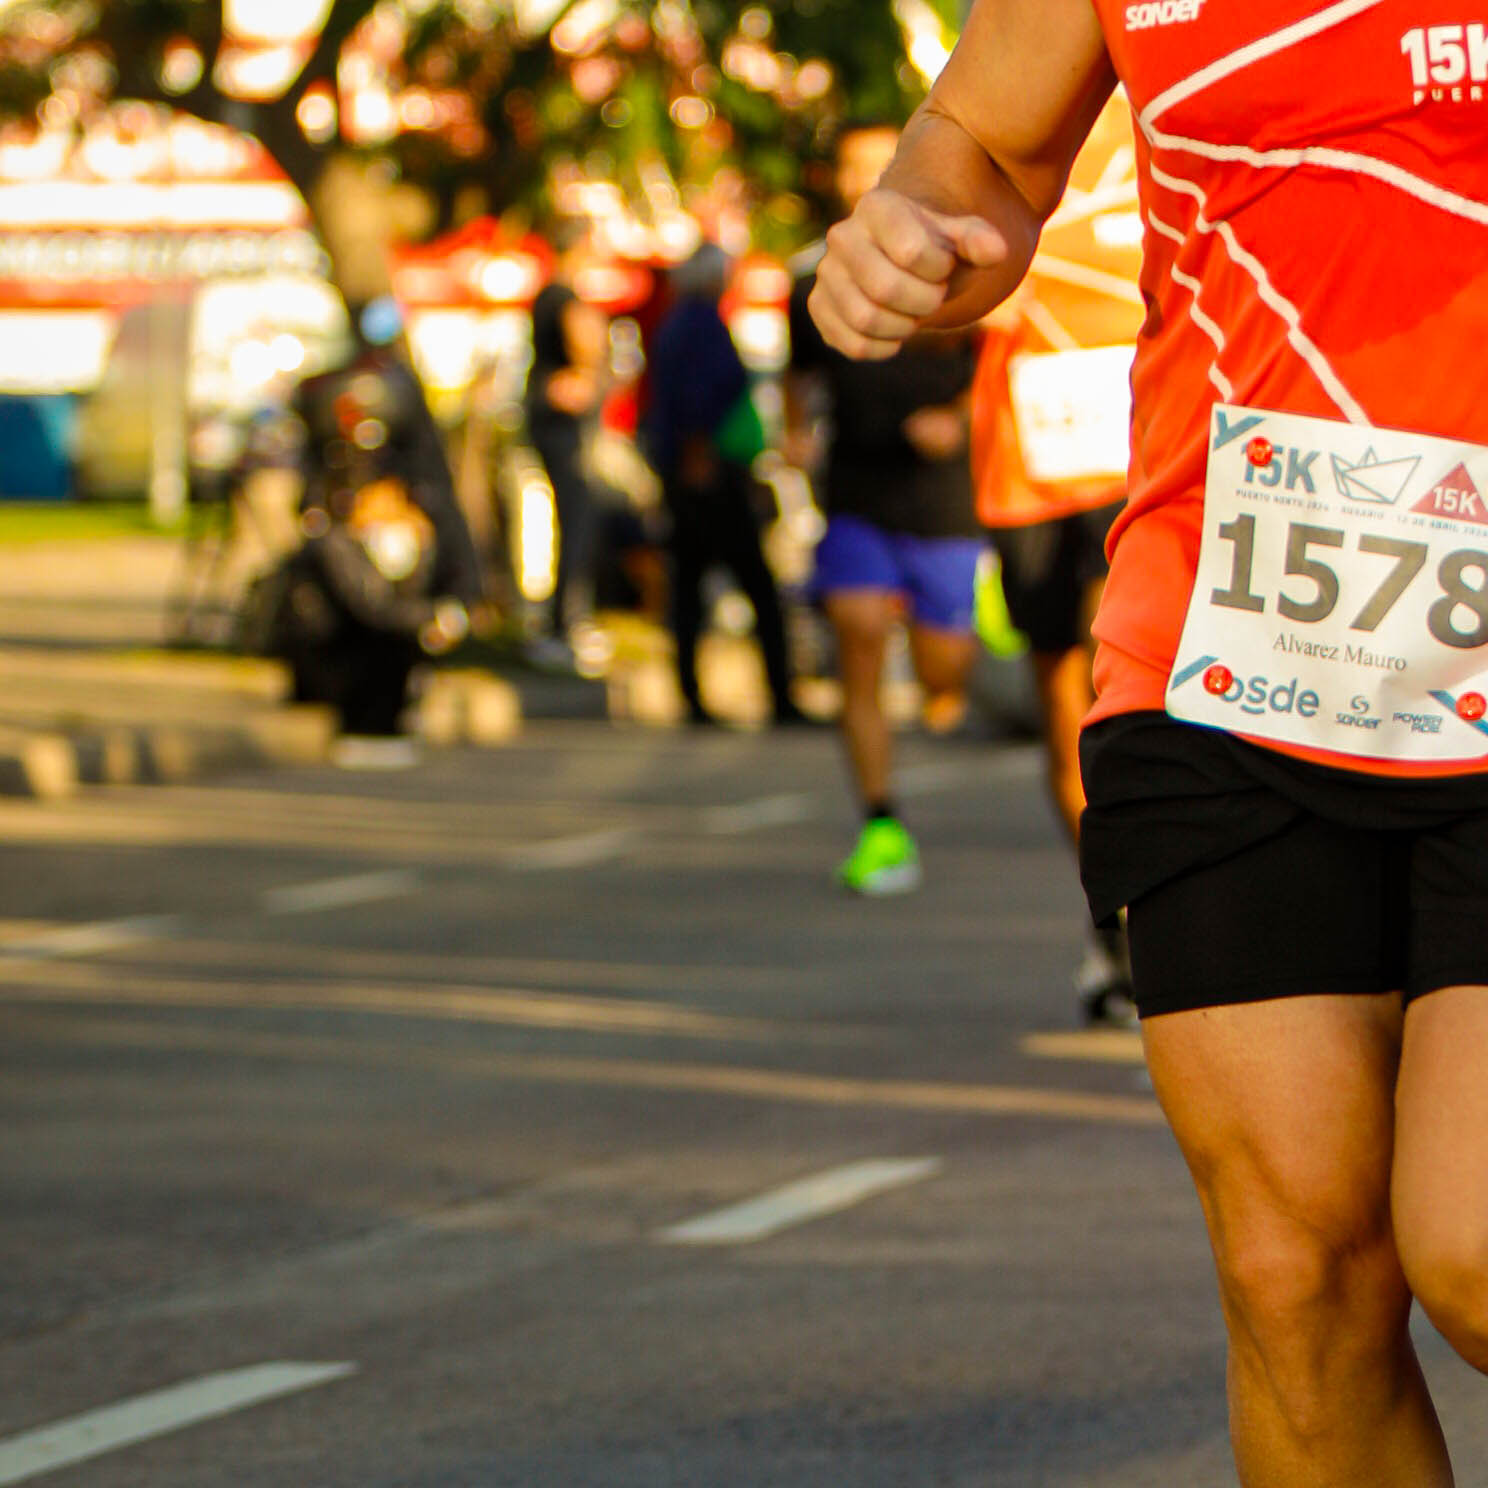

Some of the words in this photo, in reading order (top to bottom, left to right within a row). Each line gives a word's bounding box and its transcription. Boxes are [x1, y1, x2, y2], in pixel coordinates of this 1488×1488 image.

[1432, 485, 1479, 516] 15K
[1273, 632, 1338, 660] Alvarez
[1344, 645, 1407, 671] Mauro
[1219, 675, 1320, 718] osde
